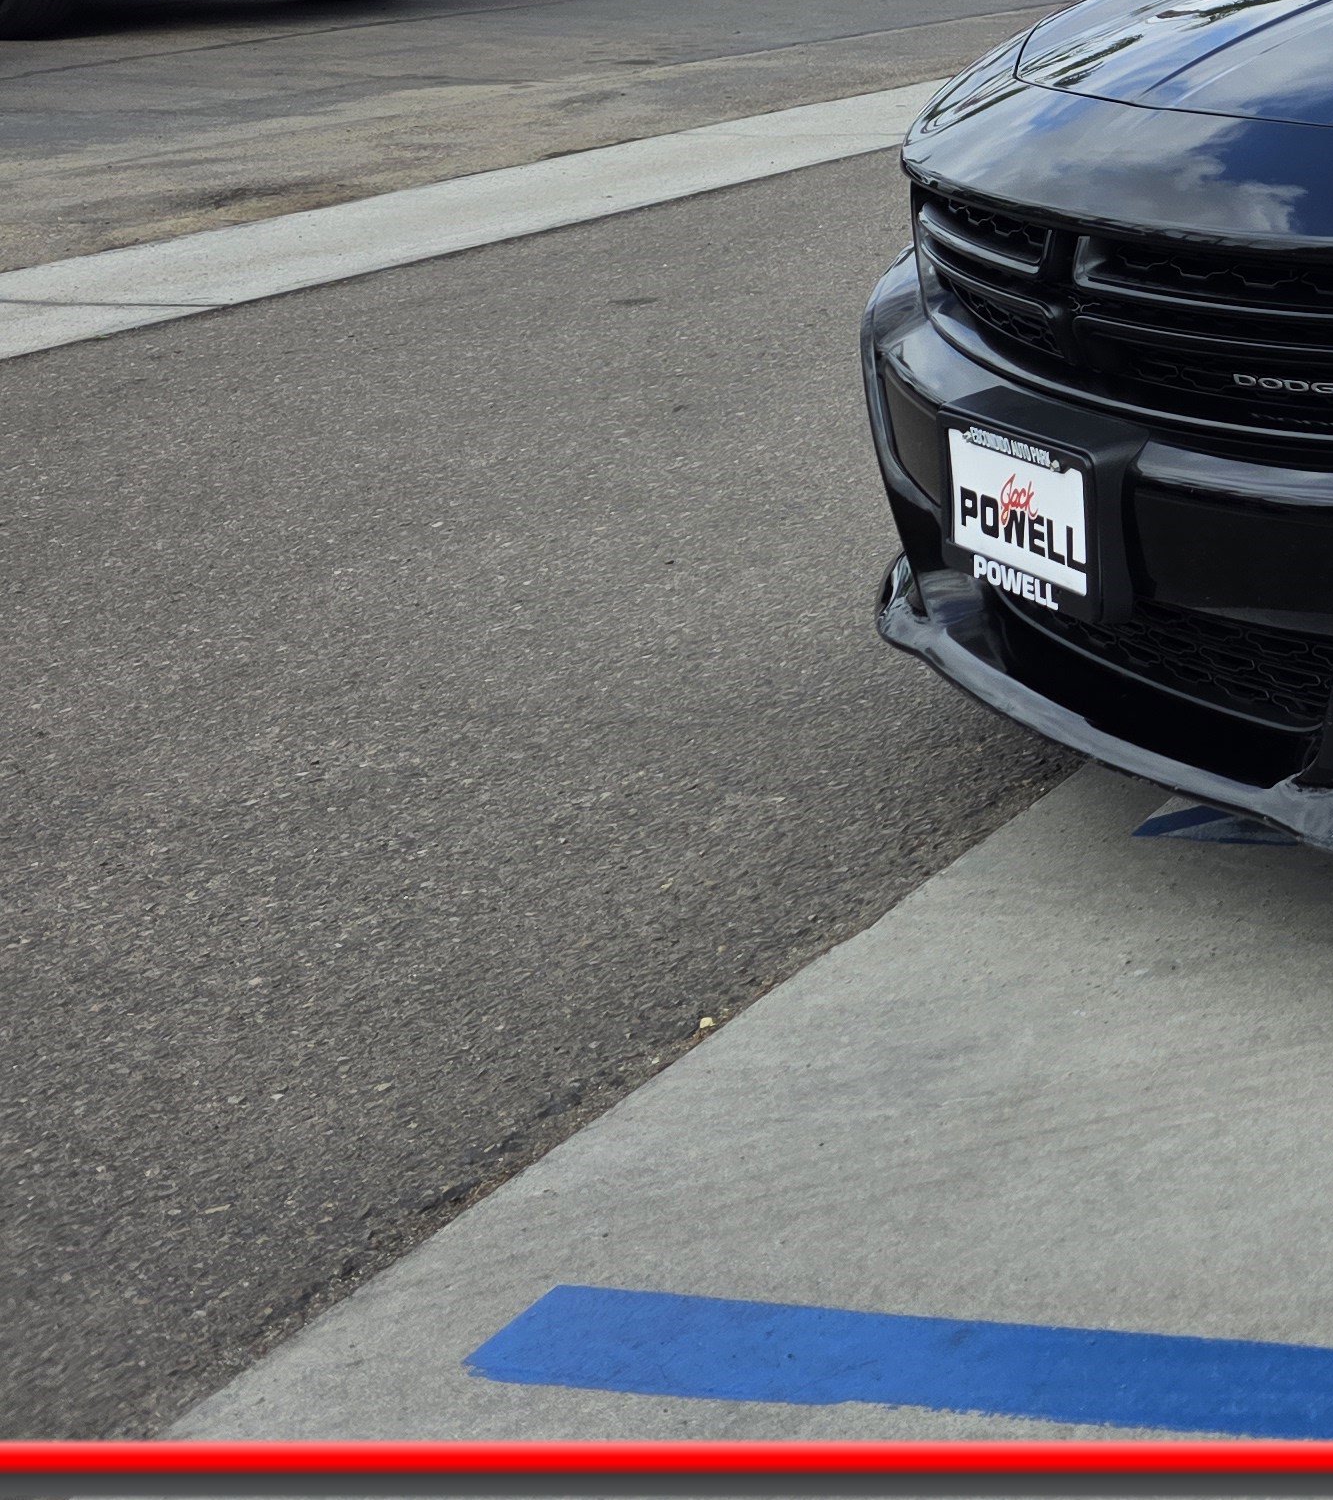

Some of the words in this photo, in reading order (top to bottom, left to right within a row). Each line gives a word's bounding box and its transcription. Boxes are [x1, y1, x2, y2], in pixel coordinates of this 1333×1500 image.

[1000, 472, 1039, 526] Jack
[959, 485, 1087, 575] POWELL
[973, 553, 1060, 612] POWELL
